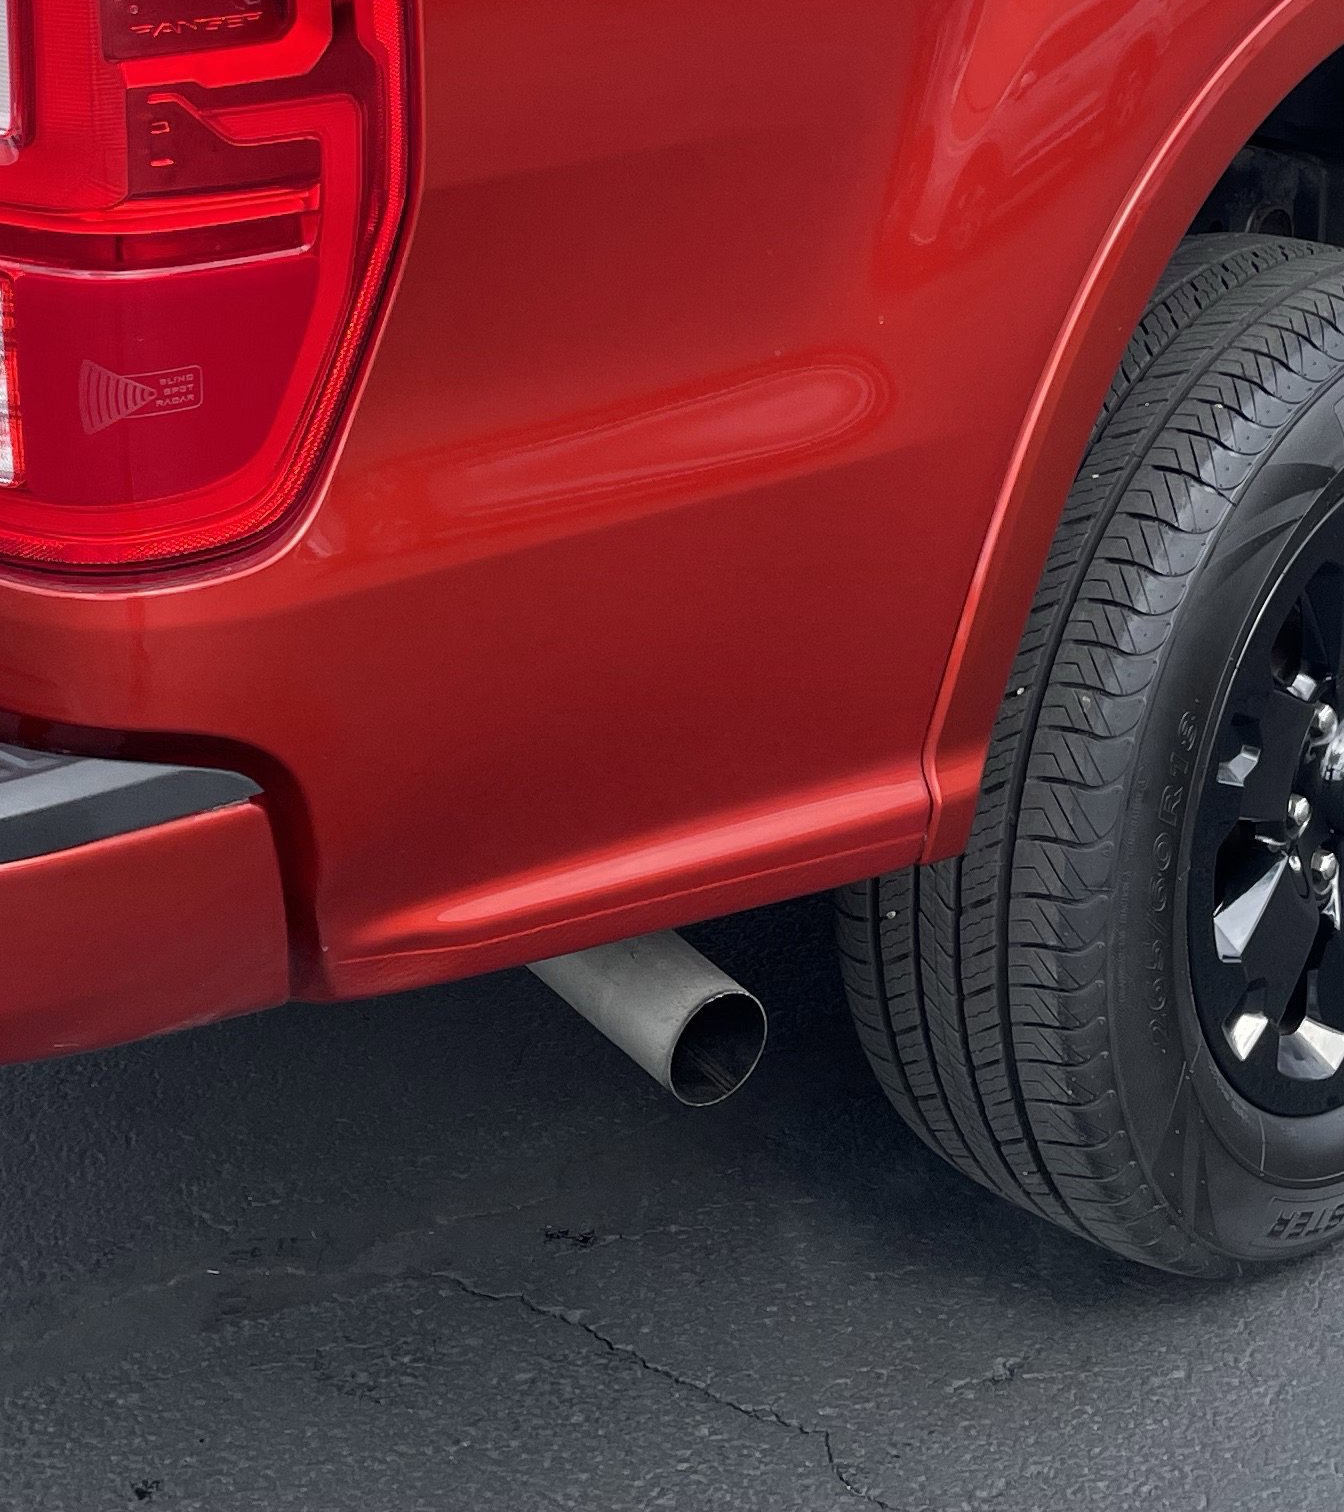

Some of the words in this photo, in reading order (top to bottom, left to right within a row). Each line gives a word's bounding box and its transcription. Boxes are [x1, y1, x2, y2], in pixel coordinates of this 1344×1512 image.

[159, 373, 194, 386] BLIND
[163, 383, 194, 396] SPOT
[155, 394, 194, 407] RADAR
